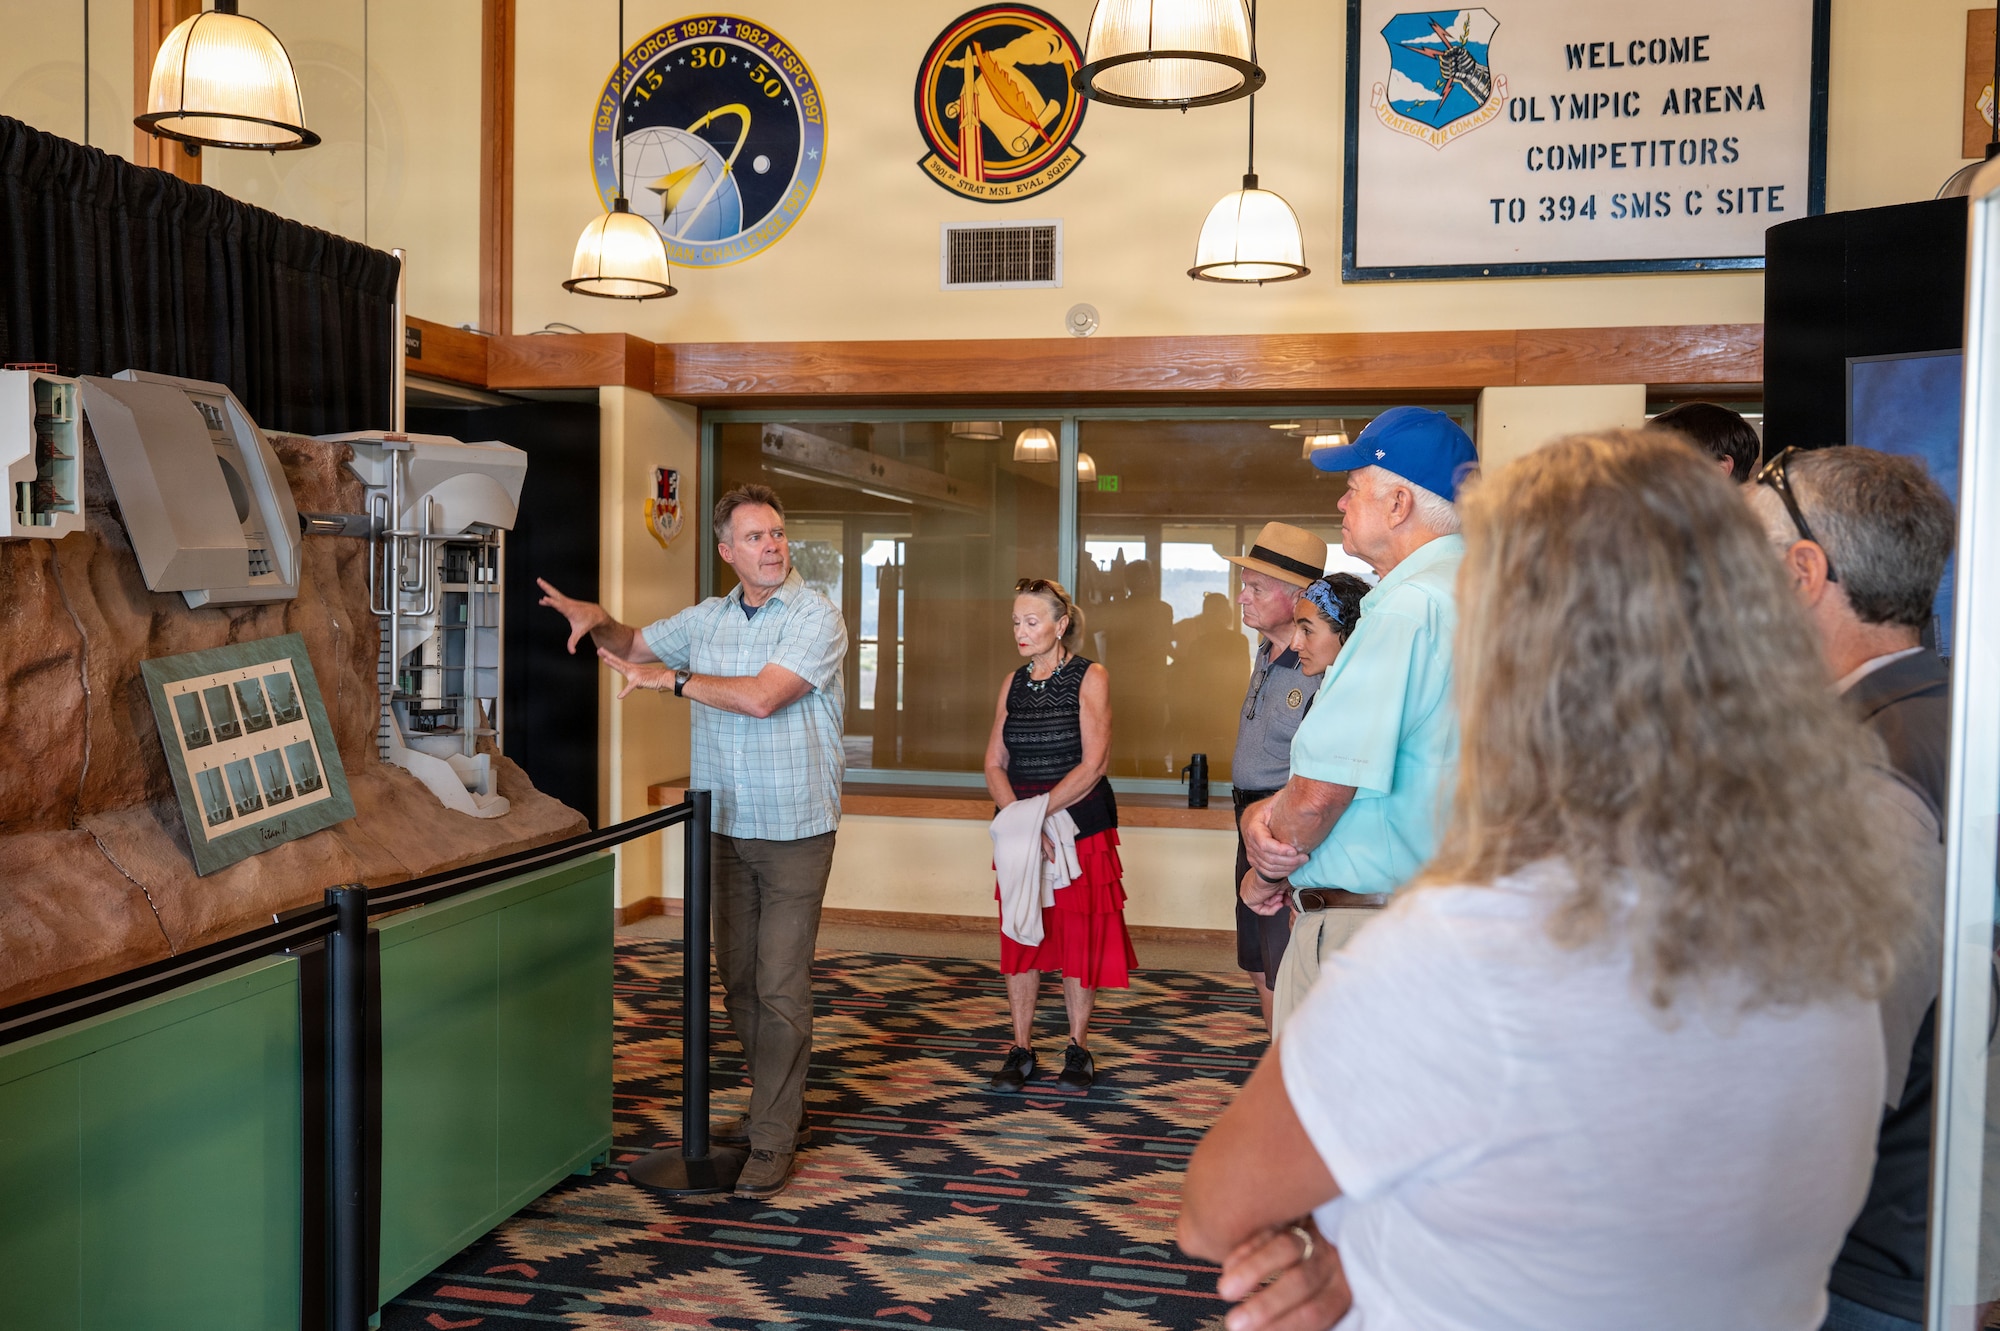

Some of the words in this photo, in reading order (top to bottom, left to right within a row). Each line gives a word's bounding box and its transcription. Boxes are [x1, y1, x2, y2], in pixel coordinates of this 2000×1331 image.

[690, 47, 726, 68] 30
[1566, 35, 1710, 70] WELCOME
[597, 94, 616, 133] 1947
[628, 28, 678, 68] FORCE
[680, 20, 717, 38] 1997
[635, 69, 663, 101] 15
[735, 23, 769, 48] 1982
[767, 42, 809, 87] AFSPC
[801, 88, 821, 124] 1997
[749, 63, 782, 98] 50
[1378, 103, 1430, 139] STRATEGIC
[1429, 129, 1449, 145] AIR
[1449, 97, 1501, 136] COMMAND
[1510, 90, 1641, 122] OLYMPIC
[1662, 84, 1766, 116] ARENA
[1527, 136, 1739, 172] COMPETITORS
[930, 160, 946, 178] 3901
[957, 180, 985, 195] STRAT
[989, 187, 1011, 196] MSL
[1016, 178, 1043, 193] EVAL
[1047, 155, 1073, 180] SQDN
[702, 214, 787, 262] CHALLENGE
[783, 179, 809, 215] 1997
[1490, 198, 1526, 224] TO
[1540, 194, 1597, 222] 394
[1611, 191, 1671, 219] SMS
[1686, 190, 1702, 216] C
[1717, 185, 1785, 215] SITE
[260, 827, 280, 841] Titan
